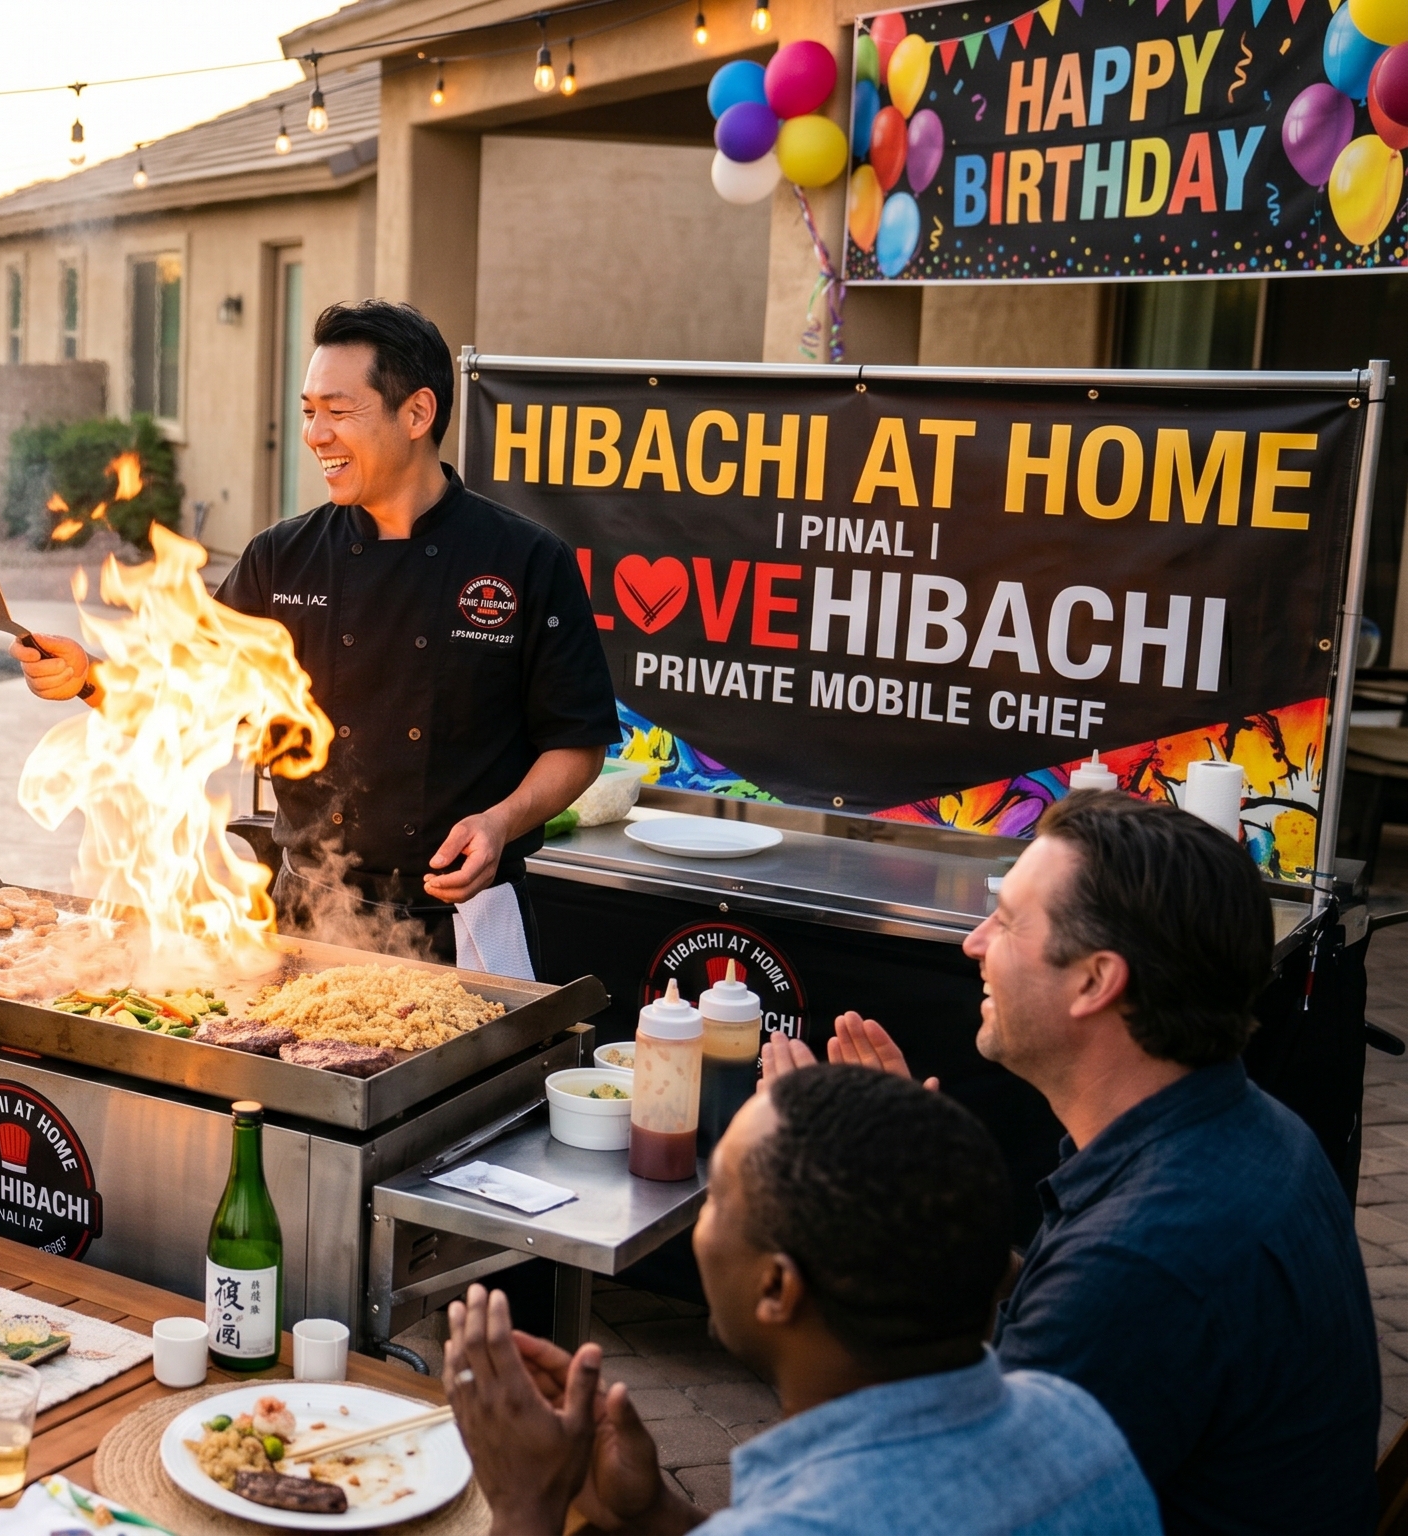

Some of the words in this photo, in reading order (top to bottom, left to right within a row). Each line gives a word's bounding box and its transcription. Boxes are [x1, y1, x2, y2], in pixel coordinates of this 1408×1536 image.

[1005, 29, 1224, 135] HAPPY
[953, 125, 1266, 228] BIRTHDAY
[493, 403, 828, 501] HIBACHI
[852, 417, 977, 509] AT
[1004, 422, 1319, 531] HOME
[800, 514, 914, 558] PINAL
[635, 651, 795, 704] PRIVATE
[810, 670, 972, 726] MOBILE
[988, 690, 1106, 740] CHEF
[663, 932, 724, 971] HIBACHI
[727, 935, 750, 953] AT
[750, 946, 790, 993] HOME
[13, 1099, 35, 1121] AT
[36, 1113, 78, 1172] HOME
[0, 1174, 90, 1225] HIBACHI
[29, 1216, 44, 1232] AZ
